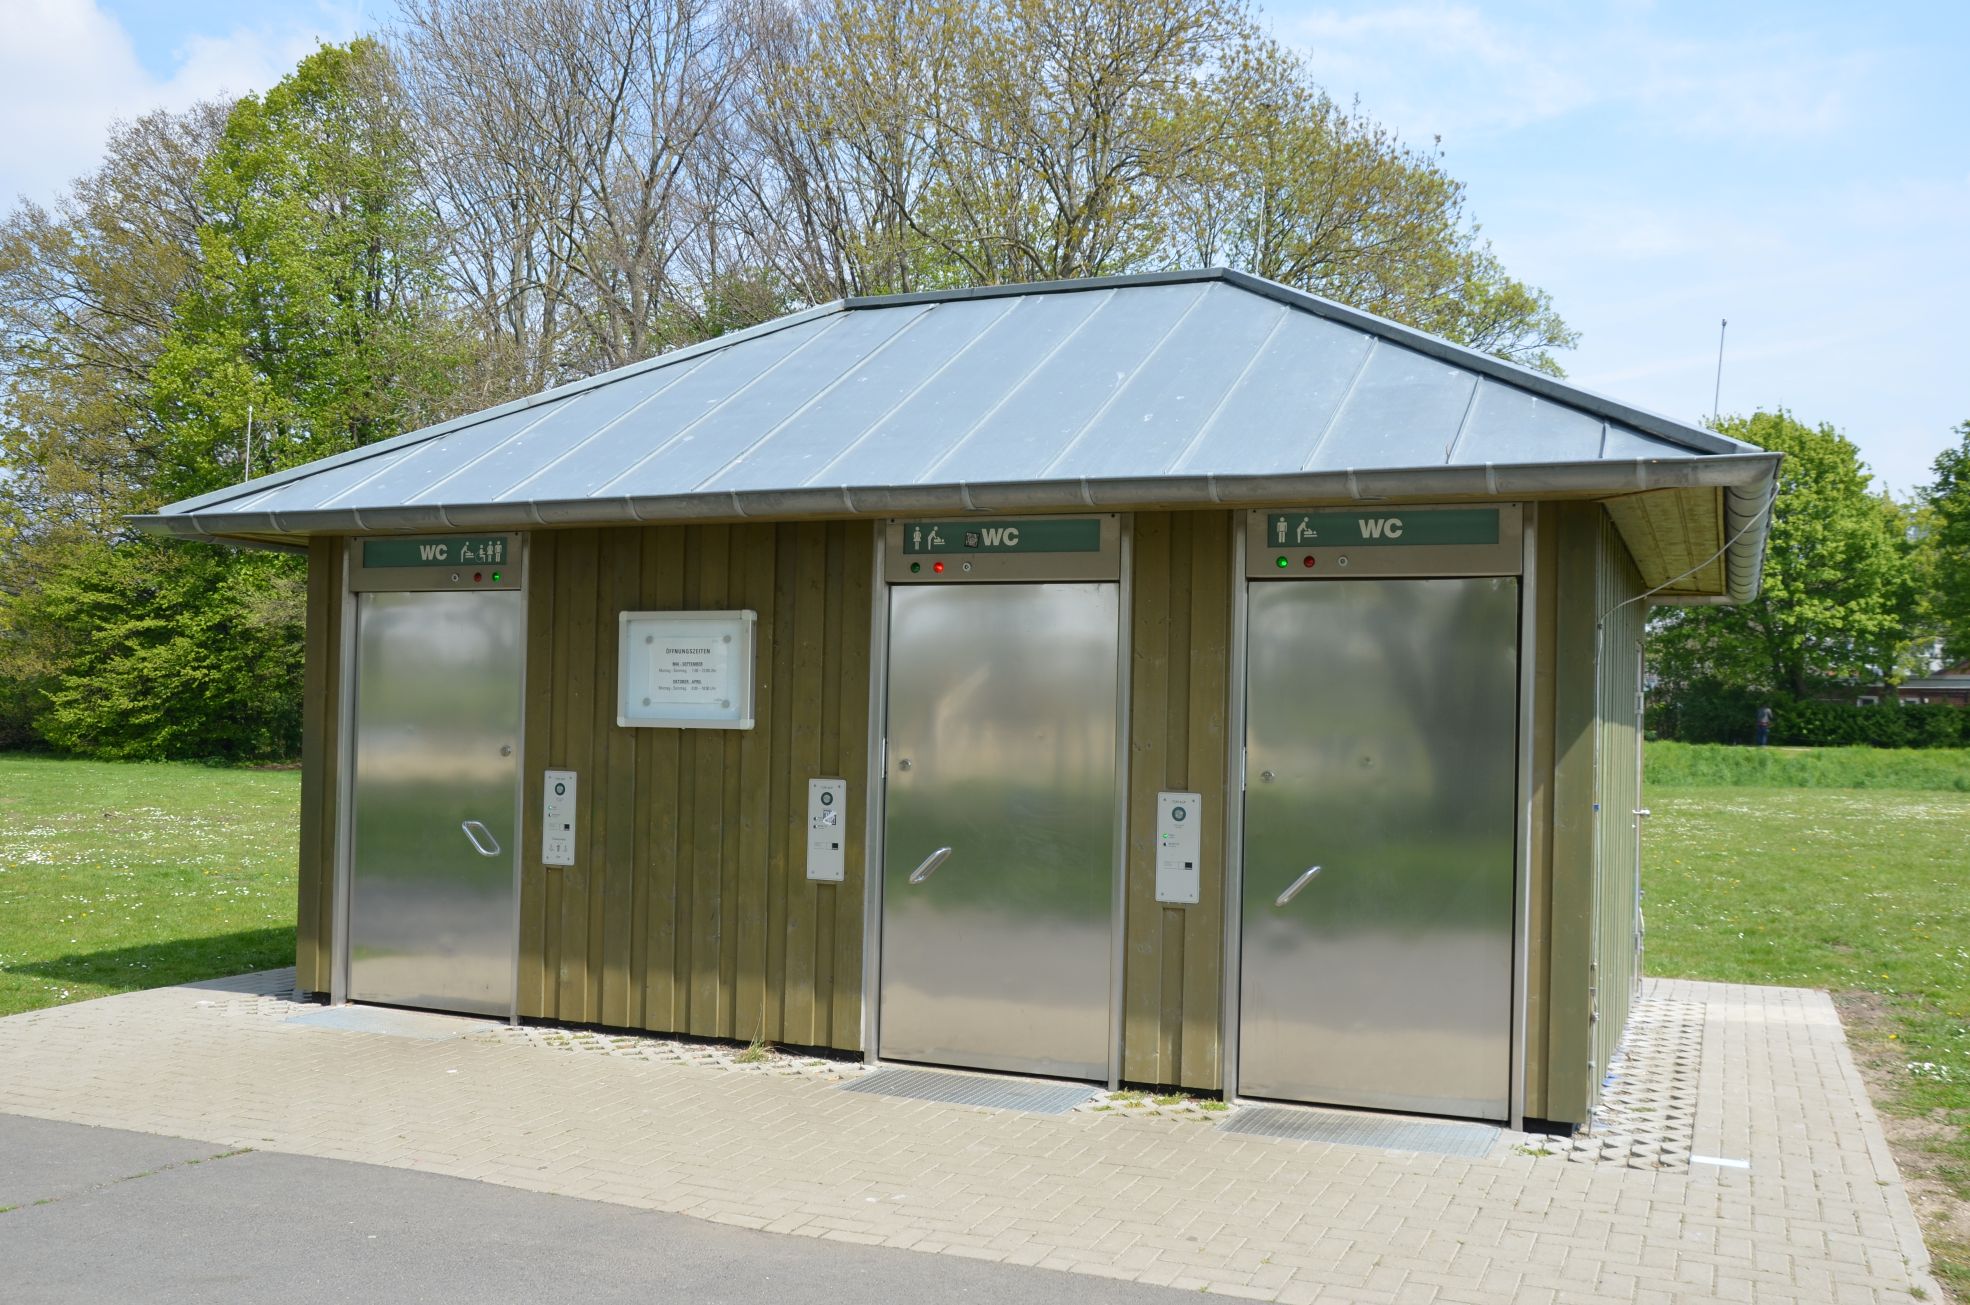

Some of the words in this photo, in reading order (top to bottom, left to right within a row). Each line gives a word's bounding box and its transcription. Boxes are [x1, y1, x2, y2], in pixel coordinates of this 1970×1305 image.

[981, 527, 1020, 546] WC
[1358, 518, 1404, 539] WC
[419, 543, 448, 561] WC
